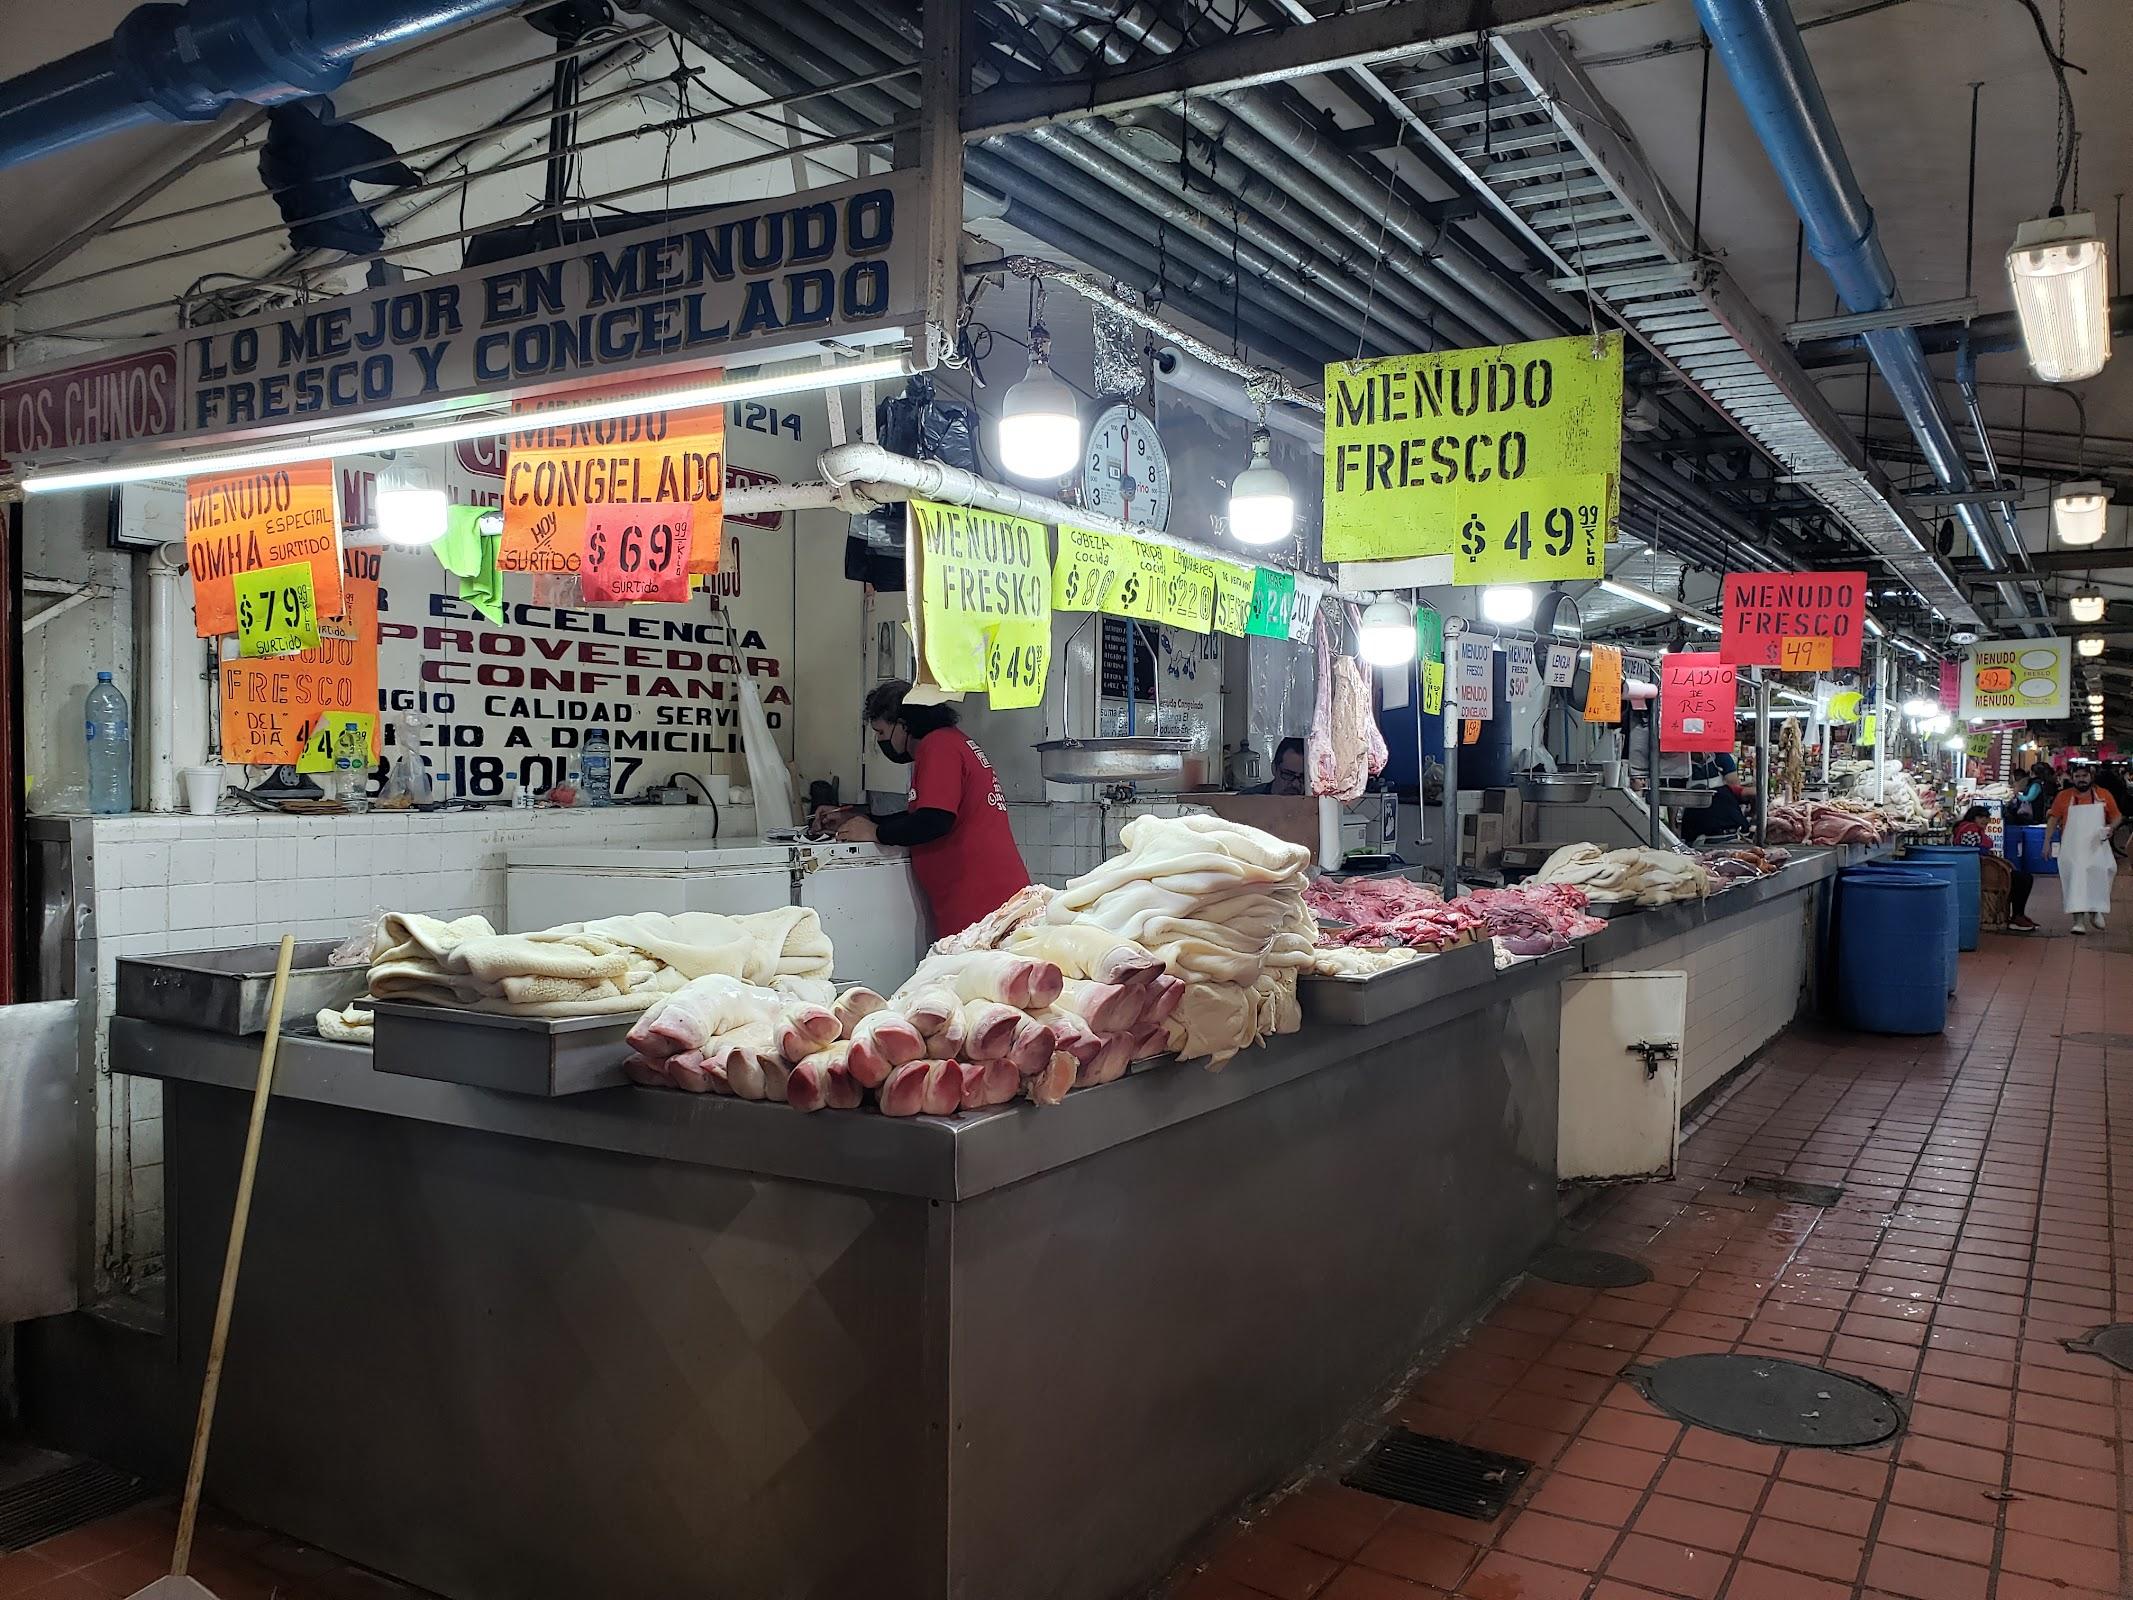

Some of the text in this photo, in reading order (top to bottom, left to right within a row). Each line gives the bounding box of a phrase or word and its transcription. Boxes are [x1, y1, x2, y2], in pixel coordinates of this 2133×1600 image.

[197, 188, 896, 383] LO MEJOR EN MENUDO
[196, 259, 891, 429] FRESCO Y CONGELADO
[64, 363, 170, 450] CHINOS
[1336, 359, 1553, 428] MENUDO
[732, 400, 802, 441] 1214
[1092, 453, 1156, 483] 2 8
[1137, 438, 1145, 456] 9
[1335, 431, 1528, 493] FRESCO
[509, 451, 722, 507] CONGELADO
[188, 470, 290, 532] MENUDO
[1092, 487, 1101, 506] 3
[1149, 498, 1158, 516] 7
[531, 511, 557, 544] HOY
[588, 524, 674, 574] $69
[917, 507, 1033, 569] MENUDO
[1460, 506, 1575, 563] $49
[191, 530, 264, 583] OMHA
[239, 586, 300, 635] $79
[943, 564, 1042, 616] FRESKO
[1735, 585, 1853, 609] MENUDO
[429, 593, 767, 650] ECELENCIA
[1738, 612, 1849, 637] FRESCO
[989, 643, 1038, 689] $49
[1671, 669, 1734, 686] LABIO
[1976, 651, 2017, 665] MENUDO
[227, 669, 352, 707] FRESCO
[484, 695, 633, 723] CALIDAD
[1461, 685, 1488, 702] MENUDO
[1679, 700, 1717, 714] RES
[1975, 694, 2015, 708] MENUDO
[503, 725, 533, 748] A
